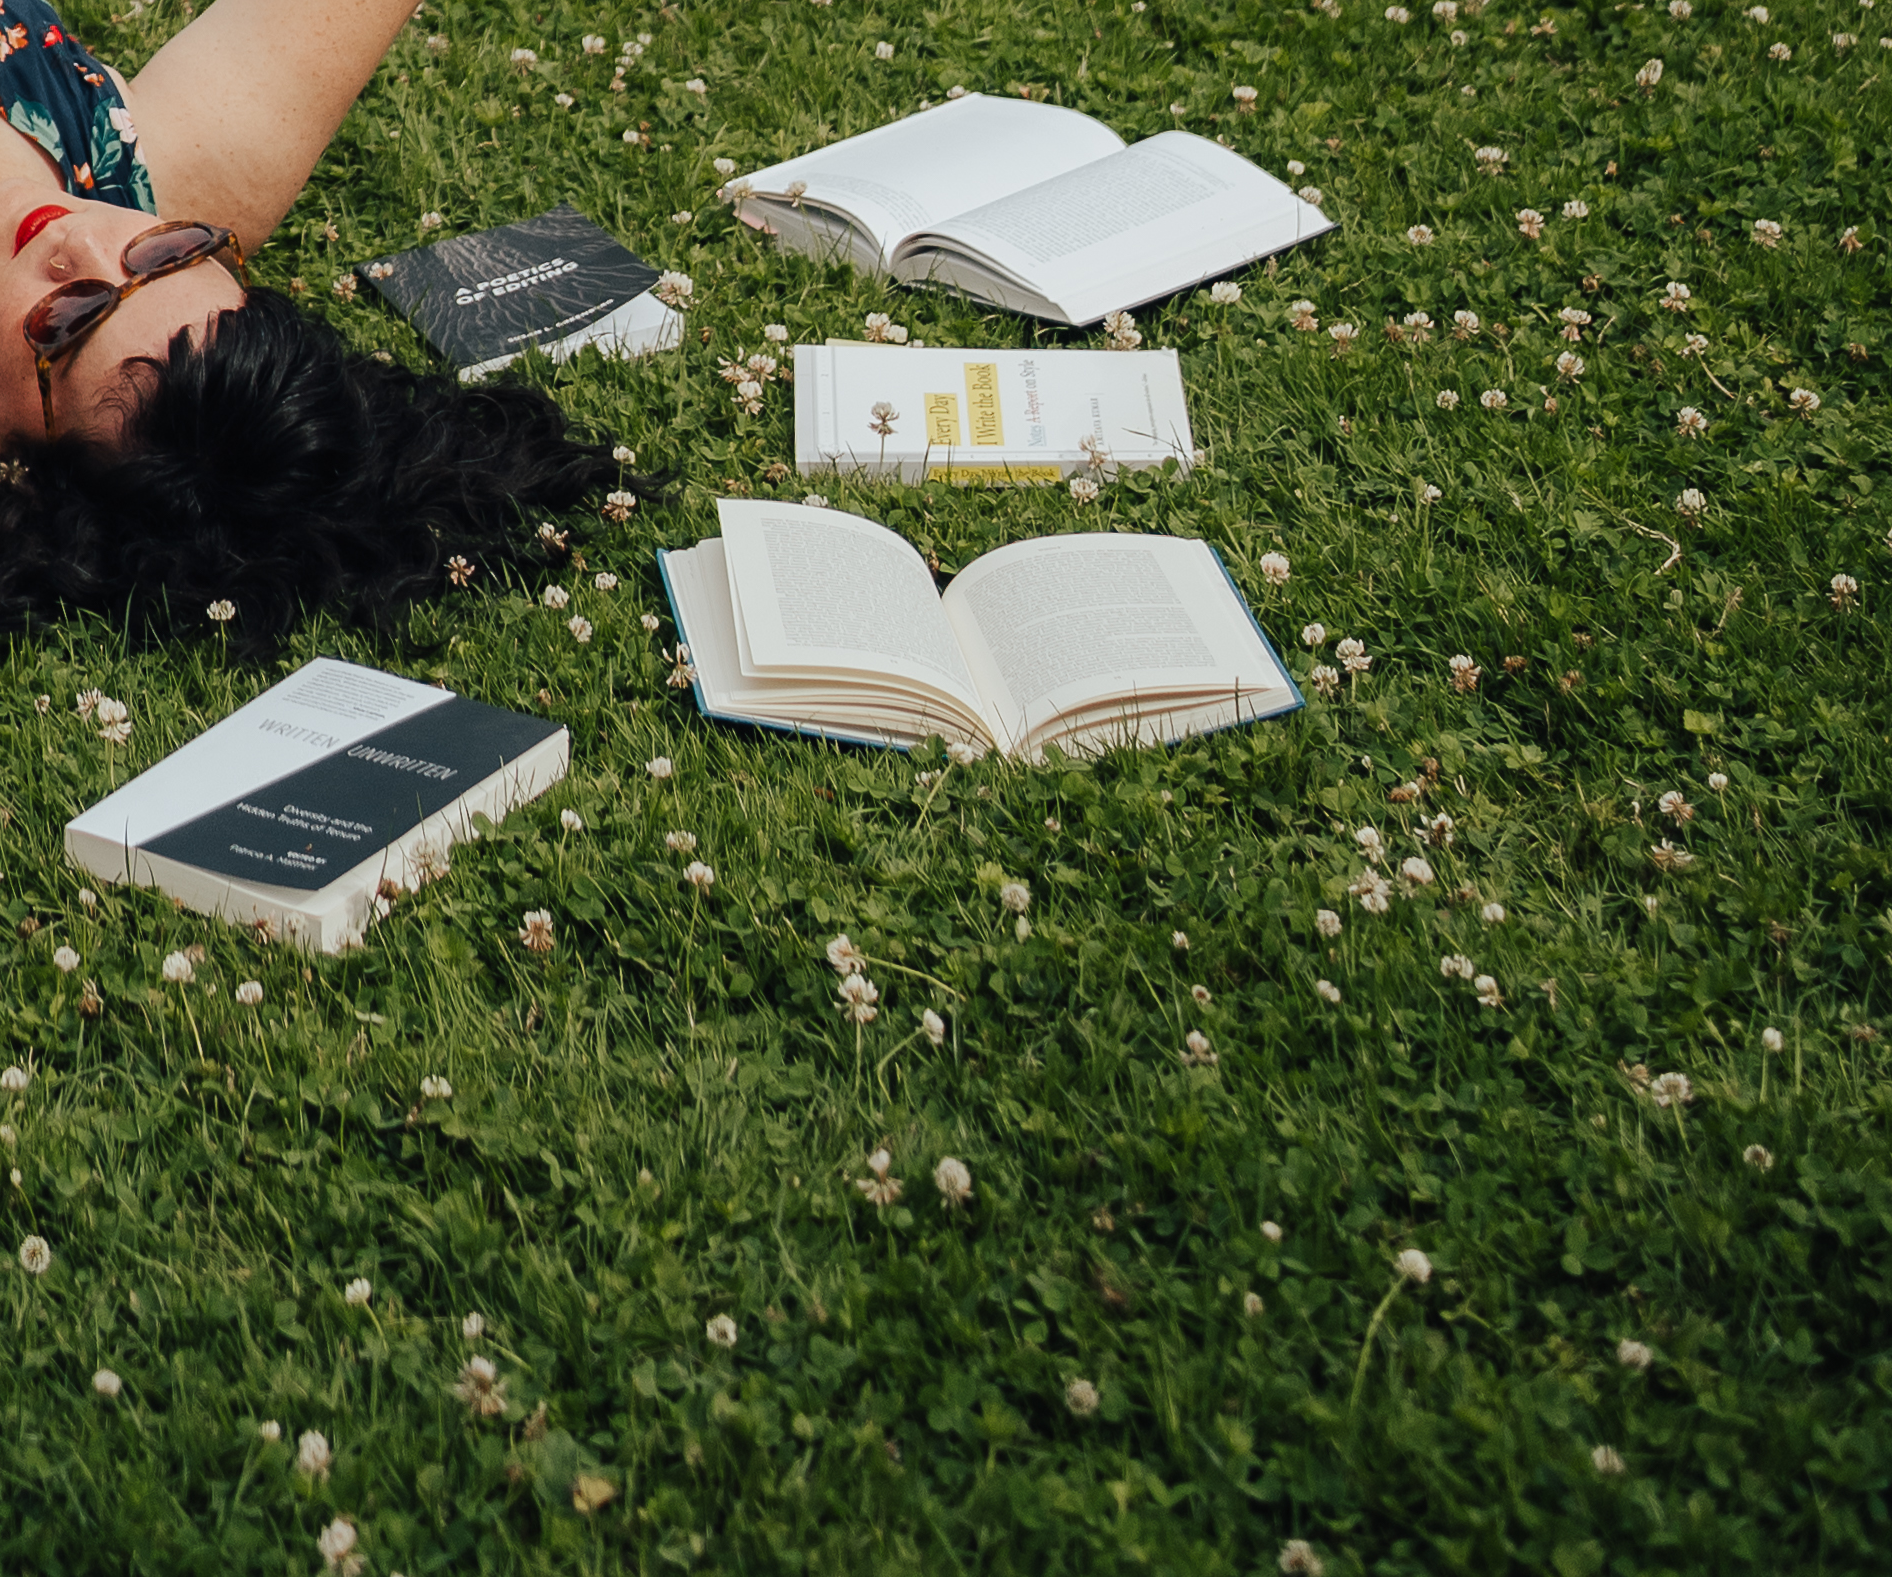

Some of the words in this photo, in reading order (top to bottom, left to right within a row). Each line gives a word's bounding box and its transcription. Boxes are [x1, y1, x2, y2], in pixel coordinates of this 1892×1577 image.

[456, 287, 472, 297] A
[476, 257, 565, 290] POETICS
[456, 291, 486, 305] OF
[492, 261, 579, 296] EDITING
[971, 364, 994, 392] Book
[1019, 360, 1039, 378] Style
[1022, 379, 1038, 389] on
[929, 395, 955, 414] Day
[973, 393, 994, 408] the
[930, 417, 957, 445] Every
[976, 411, 996, 438] Write
[1026, 425, 1048, 447] Notes
[259, 719, 339, 748] WRITTEN
[347, 745, 457, 780] UNWRITTEN
[236, 802, 275, 819] Hidden
[311, 824, 327, 833] of
[283, 804, 331, 823] Diversity
[330, 818, 352, 829] and
[353, 823, 373, 833] the
